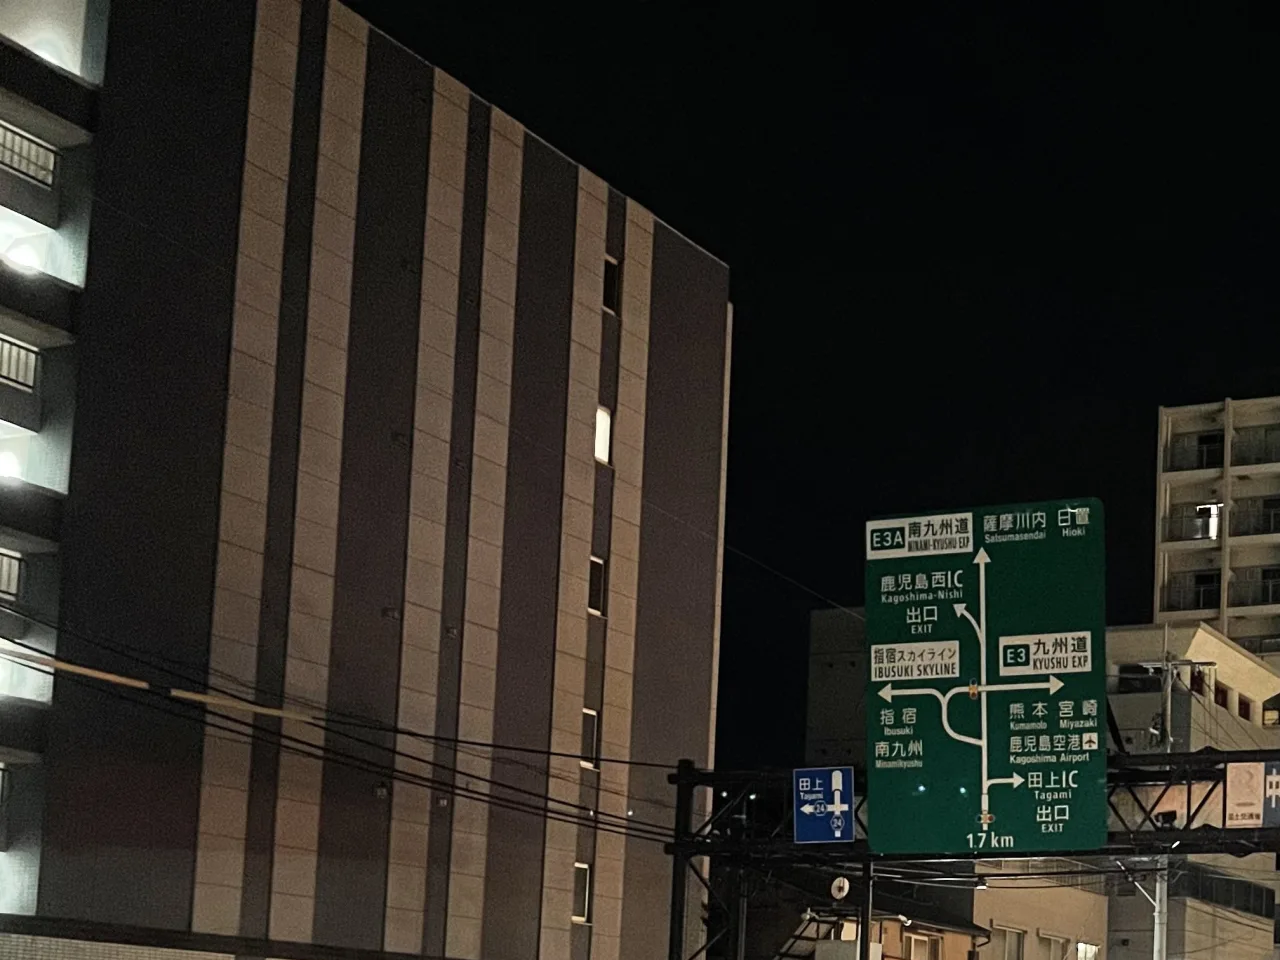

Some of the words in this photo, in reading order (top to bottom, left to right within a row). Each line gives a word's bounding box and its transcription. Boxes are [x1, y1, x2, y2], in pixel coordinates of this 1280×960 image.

[907, 518, 969, 539] 南九州道
[983, 511, 1047, 533] 薩摩川内
[872, 530, 904, 548] E3A
[907, 537, 957, 552] MINAMI-KYUSHU
[958, 535, 970, 550] EXP
[984, 531, 1047, 544] Satsumasendai
[1062, 527, 1085, 538] Hioki
[881, 569, 964, 592] 鹿児島西IC
[881, 590, 963, 604] Kagoshima-Nishi
[906, 605, 938, 624] 出口
[911, 624, 932, 634] EXIT
[1032, 637, 1088, 656] 九州道
[873, 647, 956, 665] 指宿スカイライン
[1006, 649, 1026, 664] E3
[1032, 656, 1068, 671] KYUSHU
[1072, 655, 1089, 668] EXP
[874, 665, 914, 679] IBUSUKI
[916, 663, 956, 678] SKYLINE
[880, 708, 917, 725] 指宿
[1009, 702, 1048, 719] 熊本
[1058, 700, 1098, 717] 宮崎
[884, 726, 913, 736] Ibusuki
[1010, 721, 1047, 731] Kumamoto
[1060, 719, 1097, 730] Miyazaki
[875, 740, 923, 758] 南九州
[1009, 734, 1081, 753] 鹿児島空港
[1009, 754, 1056, 765] Kagoshima
[1060, 752, 1089, 764] Airport
[799, 777, 824, 791] 田上
[1028, 770, 1079, 788] 田上IC
[1035, 789, 1072, 802] Tagami
[1036, 804, 1070, 822] 出口
[1041, 823, 1064, 833] EXIT
[966, 832, 986, 848] 1.7
[991, 832, 1014, 848] km
